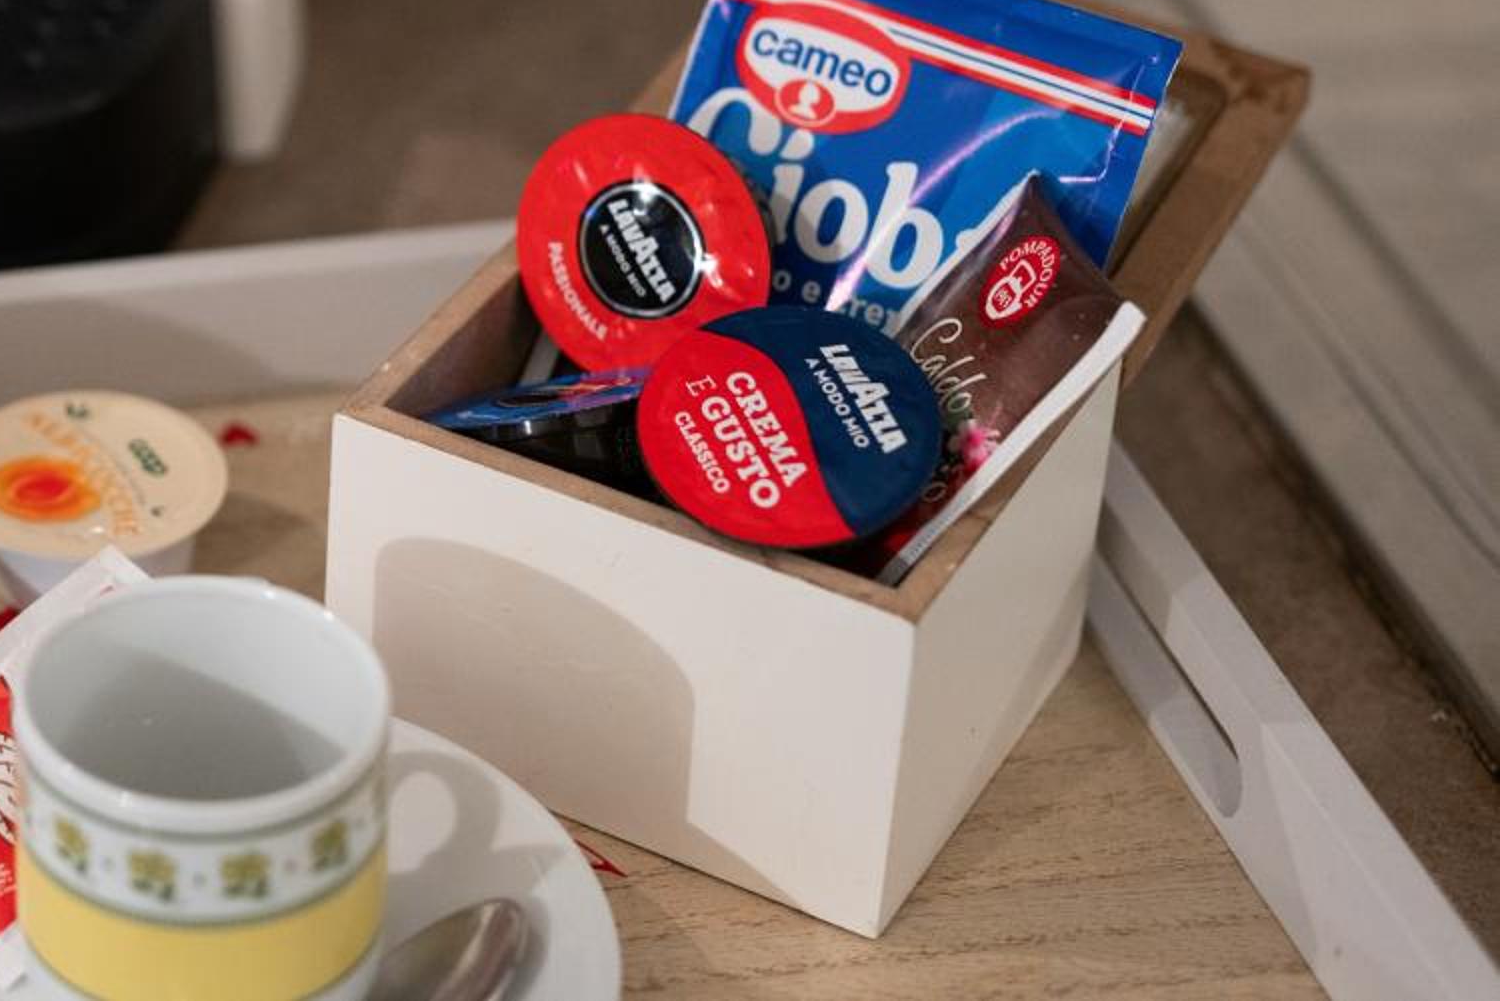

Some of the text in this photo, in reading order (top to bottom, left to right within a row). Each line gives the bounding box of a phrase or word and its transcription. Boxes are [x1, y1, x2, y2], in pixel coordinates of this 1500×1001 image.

[752, 28, 892, 98] cameo
[688, 87, 982, 289] Ciob
[607, 198, 677, 303] LAVAZZA
[999, 239, 1057, 309] POMPADOUR
[804, 358, 871, 448] A MODO MIO
[819, 343, 908, 454] LAVAZZA
[908, 317, 988, 413] Caldo
[674, 409, 732, 495] CLASSICO
[685, 373, 781, 509] E GUSTO
[726, 370, 808, 488] CREMA
